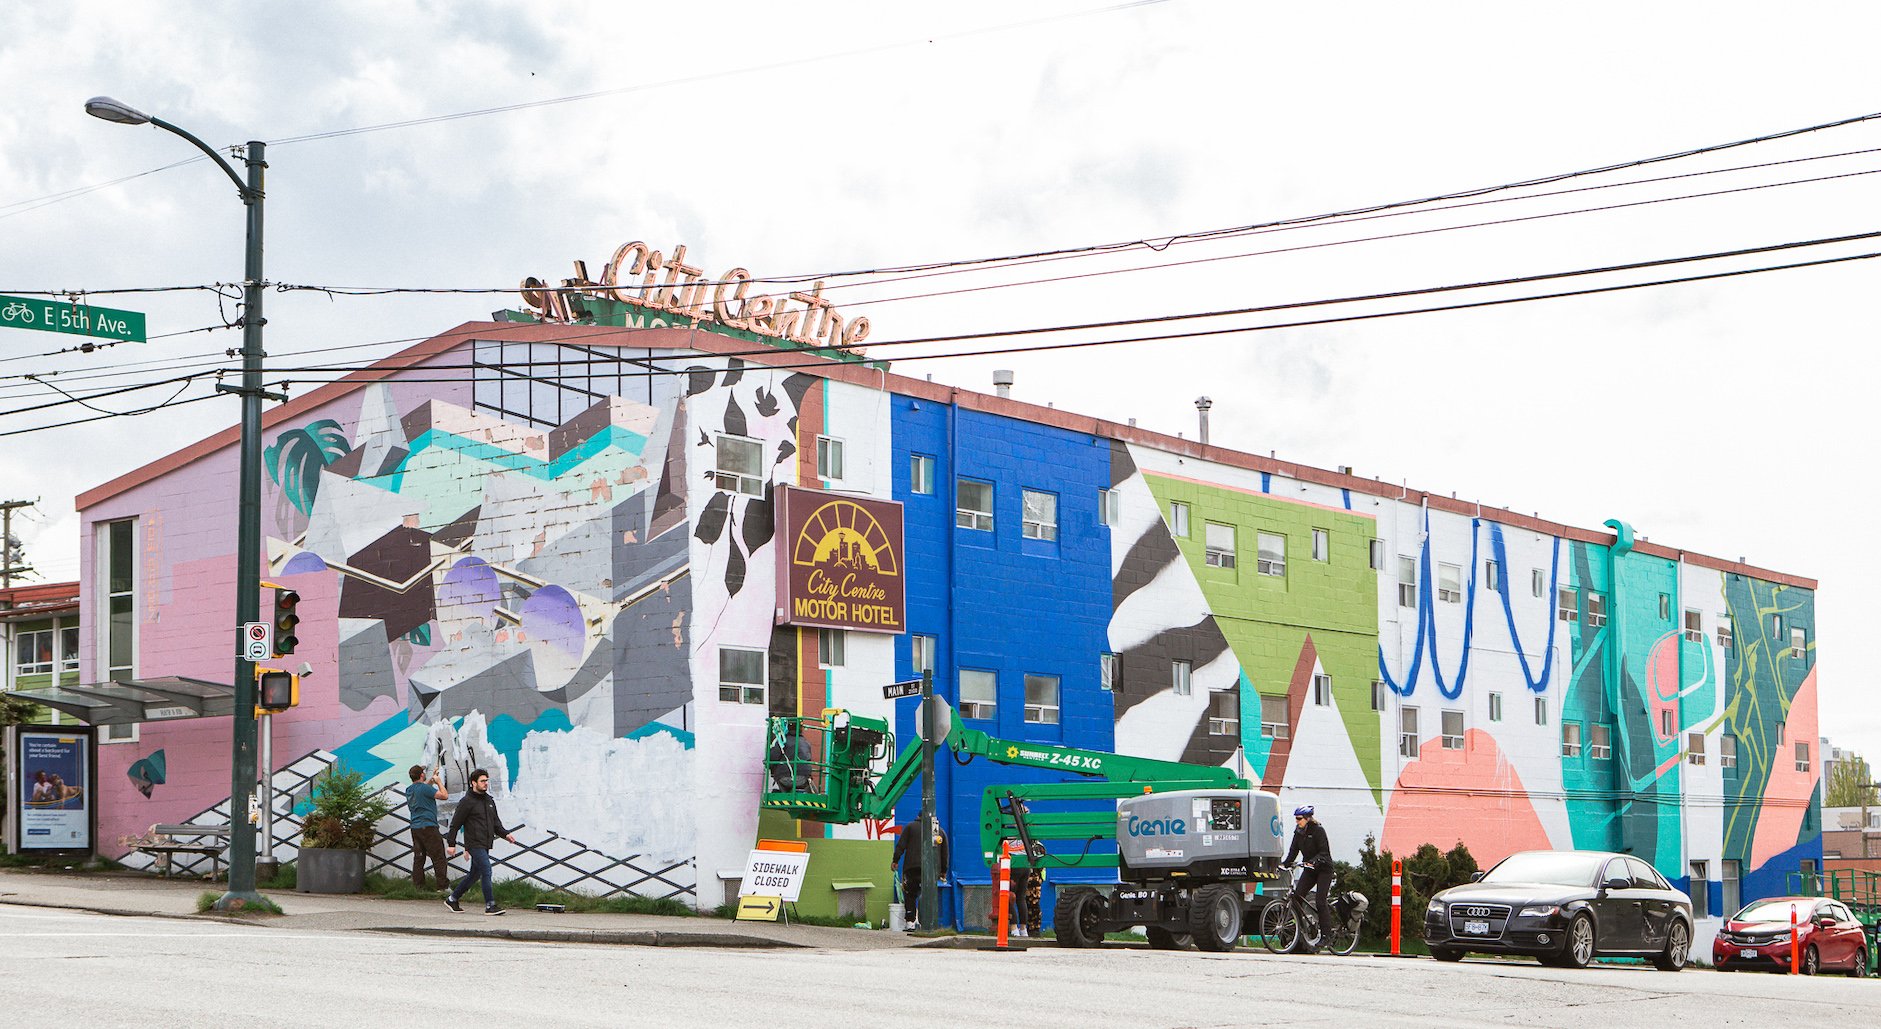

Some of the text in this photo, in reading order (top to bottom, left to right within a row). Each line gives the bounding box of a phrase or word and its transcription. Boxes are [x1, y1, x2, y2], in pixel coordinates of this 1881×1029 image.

[607, 240, 714, 329] City
[714, 267, 872, 356] Centre
[44, 306, 131, 335] E 5th Ave.
[807, 568, 886, 601] City Centre
[795, 597, 899, 625] MOTOR HOTEL
[888, 686, 904, 697] MAIN
[1050, 753, 1081, 767] Z-45
[1081, 757, 1101, 769] XC
[1128, 815, 1185, 838] Genie
[752, 862, 799, 875] SIDEWALK
[1220, 867, 1230, 876] XC
[754, 875, 789, 888] CLOSED
